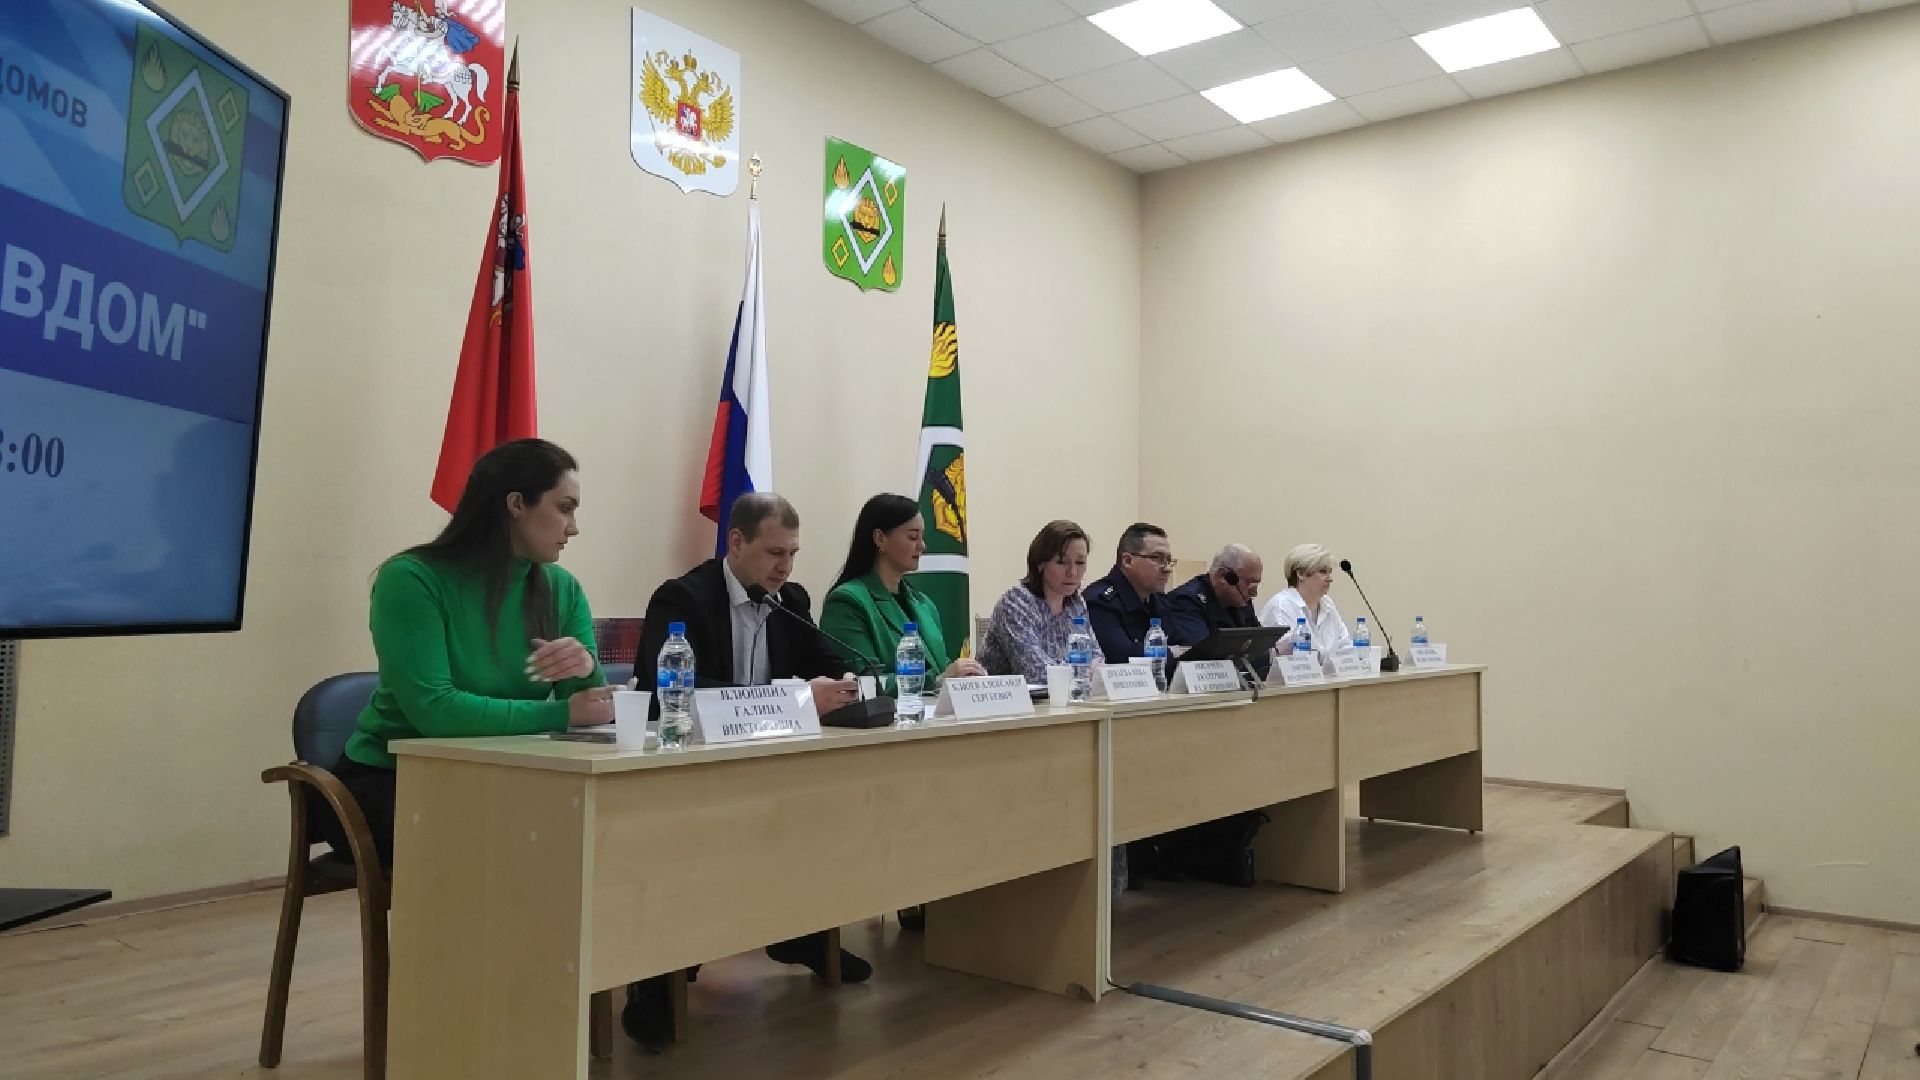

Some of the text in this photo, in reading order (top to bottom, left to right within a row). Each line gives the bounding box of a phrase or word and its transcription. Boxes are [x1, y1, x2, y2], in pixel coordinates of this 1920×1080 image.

[0, 56, 88, 128] ОМОВ
[0, 429, 65, 478] :00
[734, 704, 784, 718] ГАЛИНА
